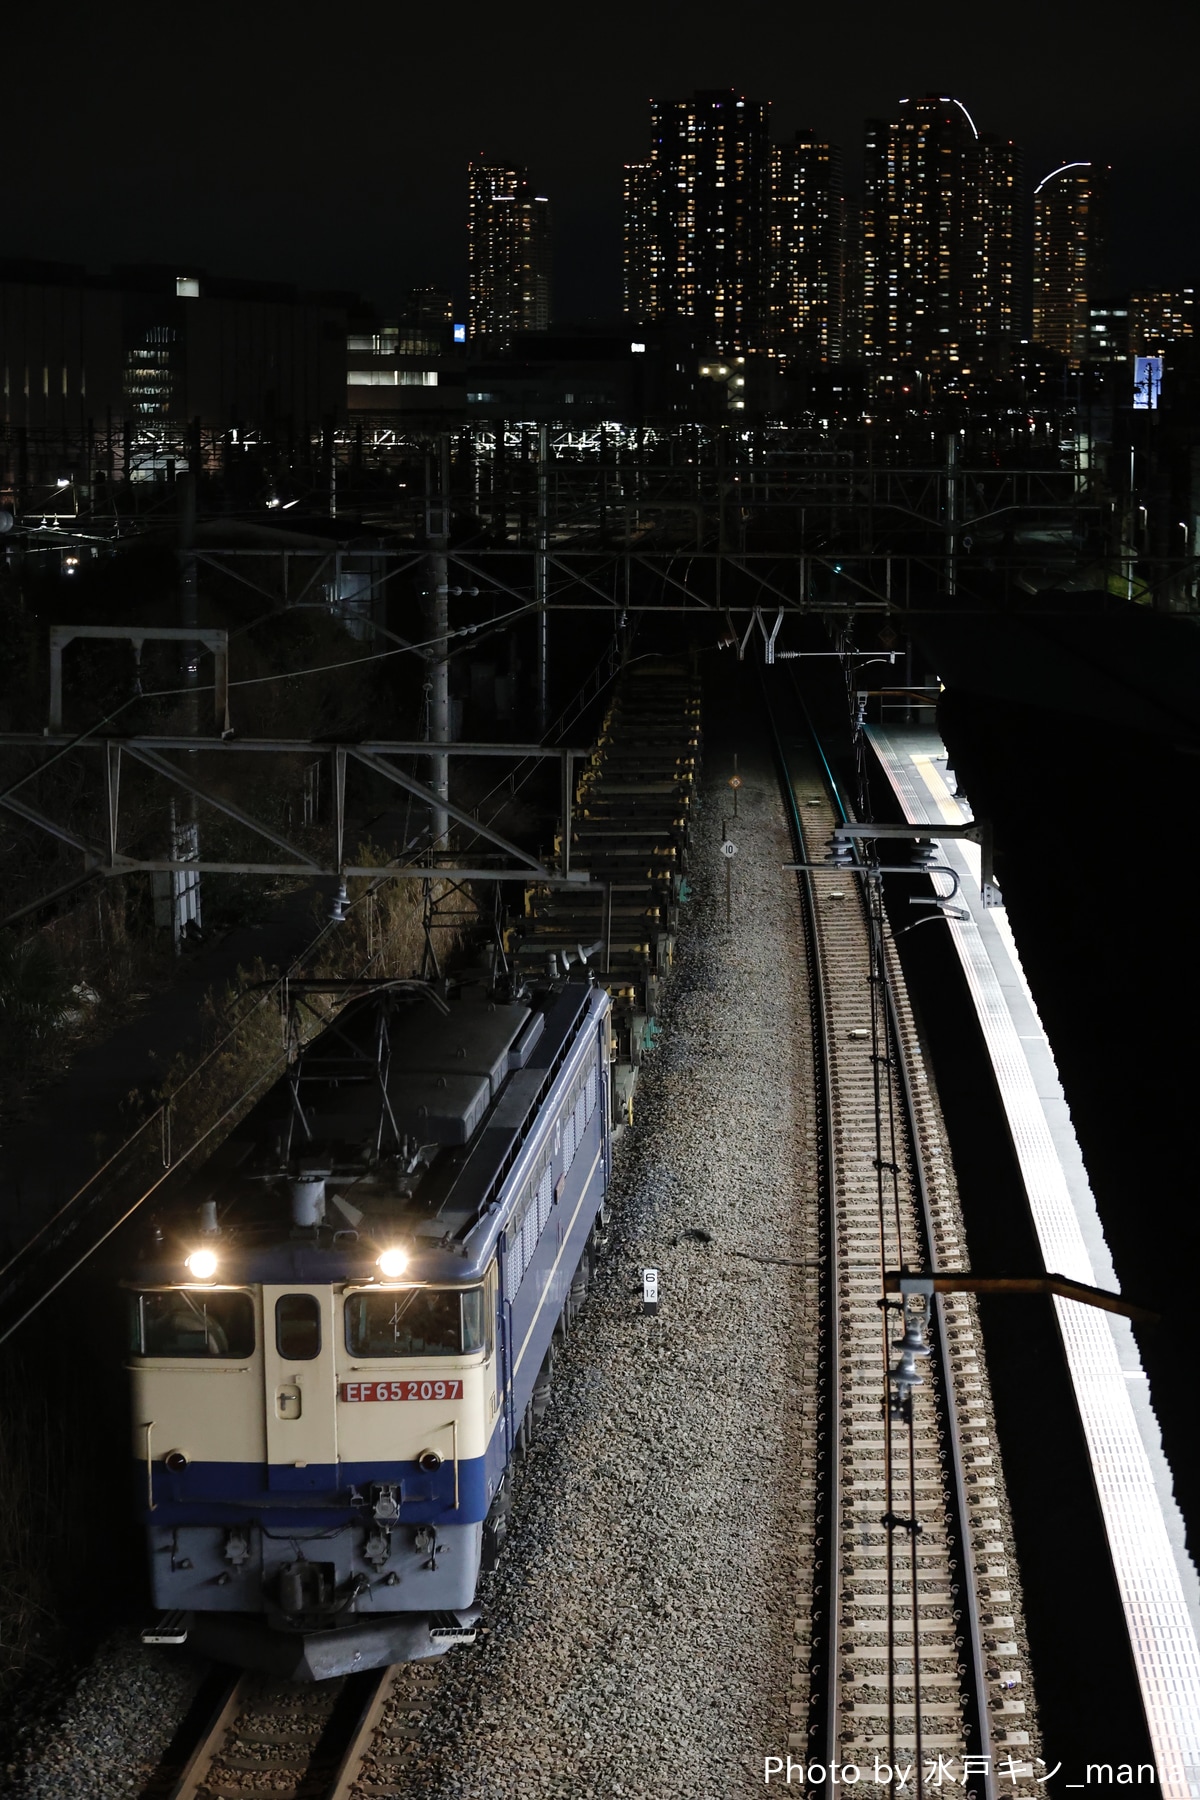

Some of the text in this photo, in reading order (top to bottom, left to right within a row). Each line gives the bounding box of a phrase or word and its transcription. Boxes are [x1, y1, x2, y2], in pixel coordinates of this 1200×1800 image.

[726, 845, 733, 854] 10
[645, 1273, 655, 1283] 6
[646, 1289, 655, 1298] 12
[407, 1381, 460, 1400] 2097
